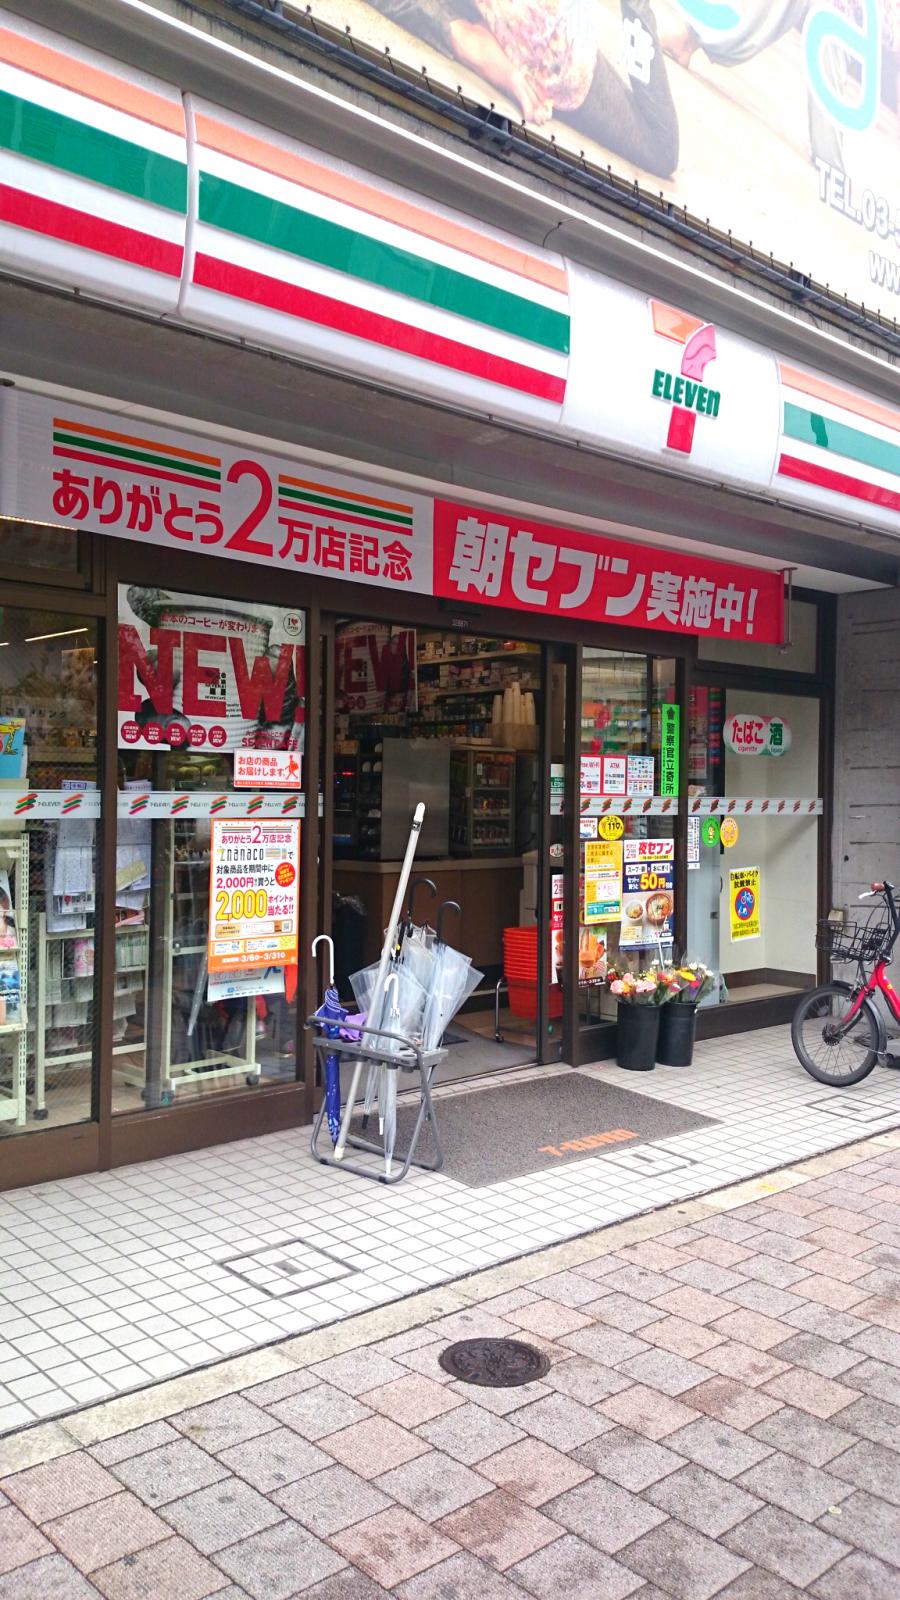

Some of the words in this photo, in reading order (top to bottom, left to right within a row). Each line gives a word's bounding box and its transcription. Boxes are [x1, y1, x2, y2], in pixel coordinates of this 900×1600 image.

[52, 459, 413, 582] ありがとう2万店記念
[448, 516, 759, 635] 朝セブン実施中!
[732, 719, 764, 745] たばこ
[769, 723, 783, 746] 酒
[238, 756, 278, 767] お店の商品
[665, 722, 675, 795] 警察官立寄所
[221, 825, 292, 844] ありがとう2万店記念
